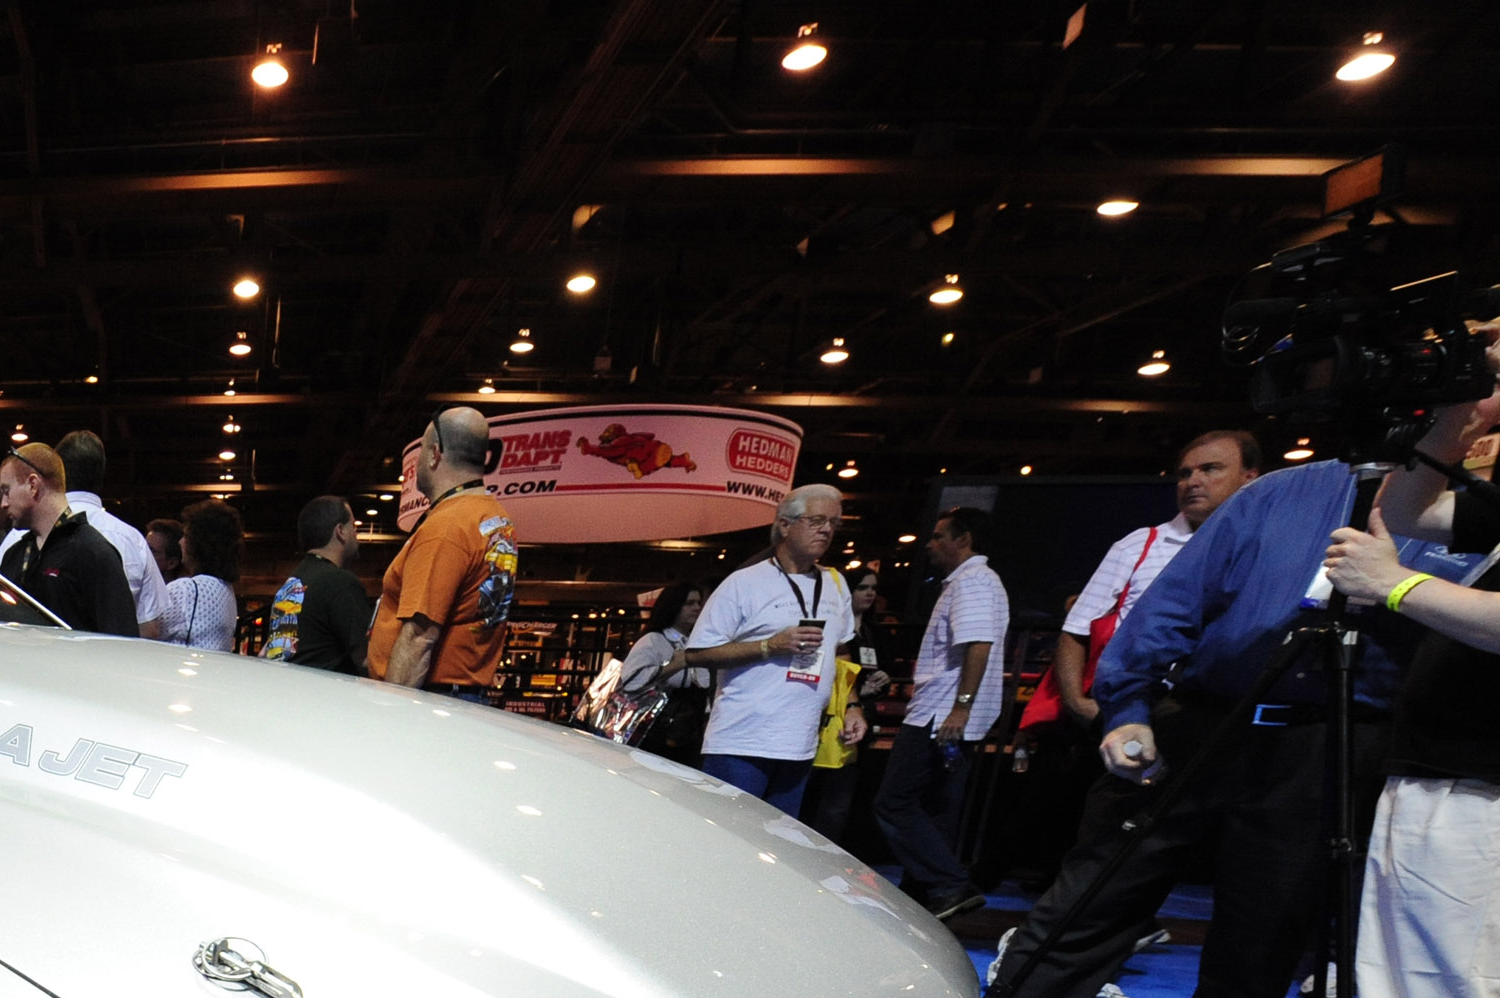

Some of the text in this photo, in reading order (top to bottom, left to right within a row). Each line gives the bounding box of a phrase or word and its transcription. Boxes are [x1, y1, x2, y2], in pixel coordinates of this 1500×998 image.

[501, 429, 573, 453] TRANS
[738, 435, 793, 463] HEDMAN
[500, 449, 567, 469] DAPT
[735, 454, 790, 479] HEDDERS
[38, 738, 188, 799] JET
